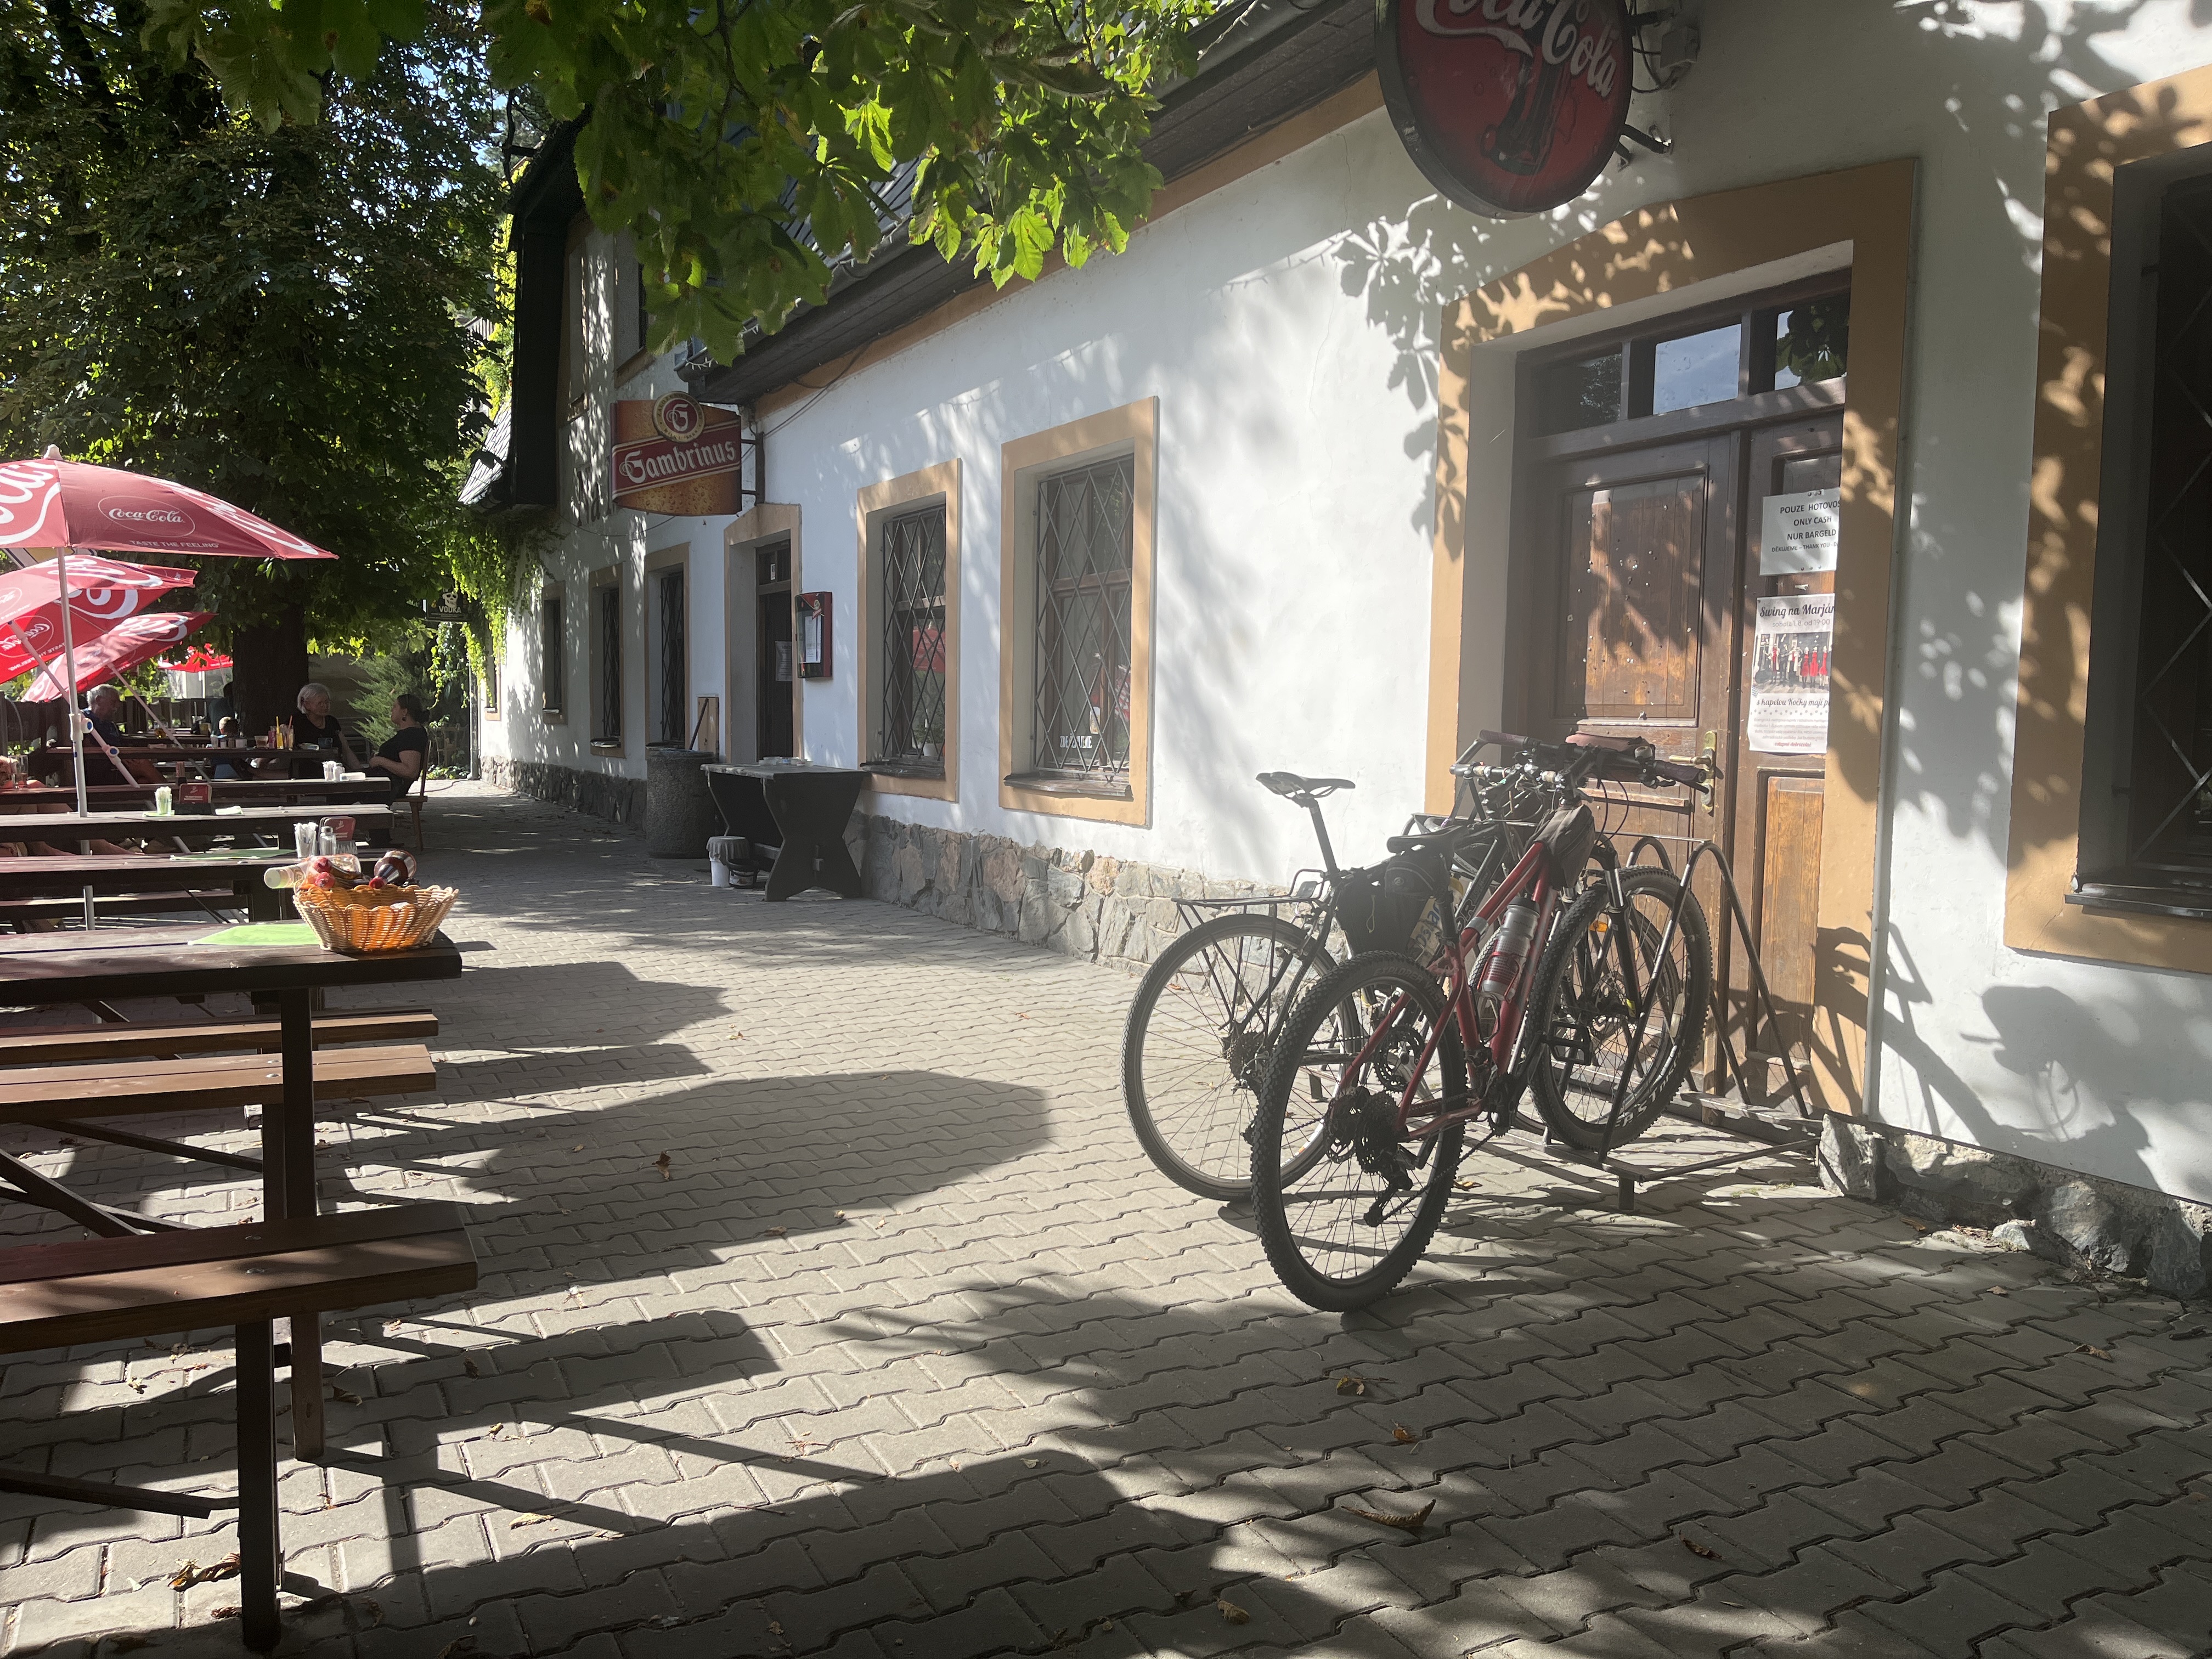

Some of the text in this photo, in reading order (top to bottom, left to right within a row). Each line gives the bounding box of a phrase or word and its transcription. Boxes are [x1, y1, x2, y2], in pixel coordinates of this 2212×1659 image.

[619, 441, 737, 484] Gambrinus
[1780, 505, 1804, 514] POUZE
[109, 508, 183, 523] Coca-Cola
[1793, 515, 1832, 526] ONLY CASH
[1787, 529, 1836, 540] NUR BARGELD
[1759, 606, 1787, 619] Swing
[1788, 607, 1799, 616] na
[1761, 698, 1786, 707] kapelou
[1787, 698, 1808, 708] Kočky
[1808, 698, 1824, 708] mají
